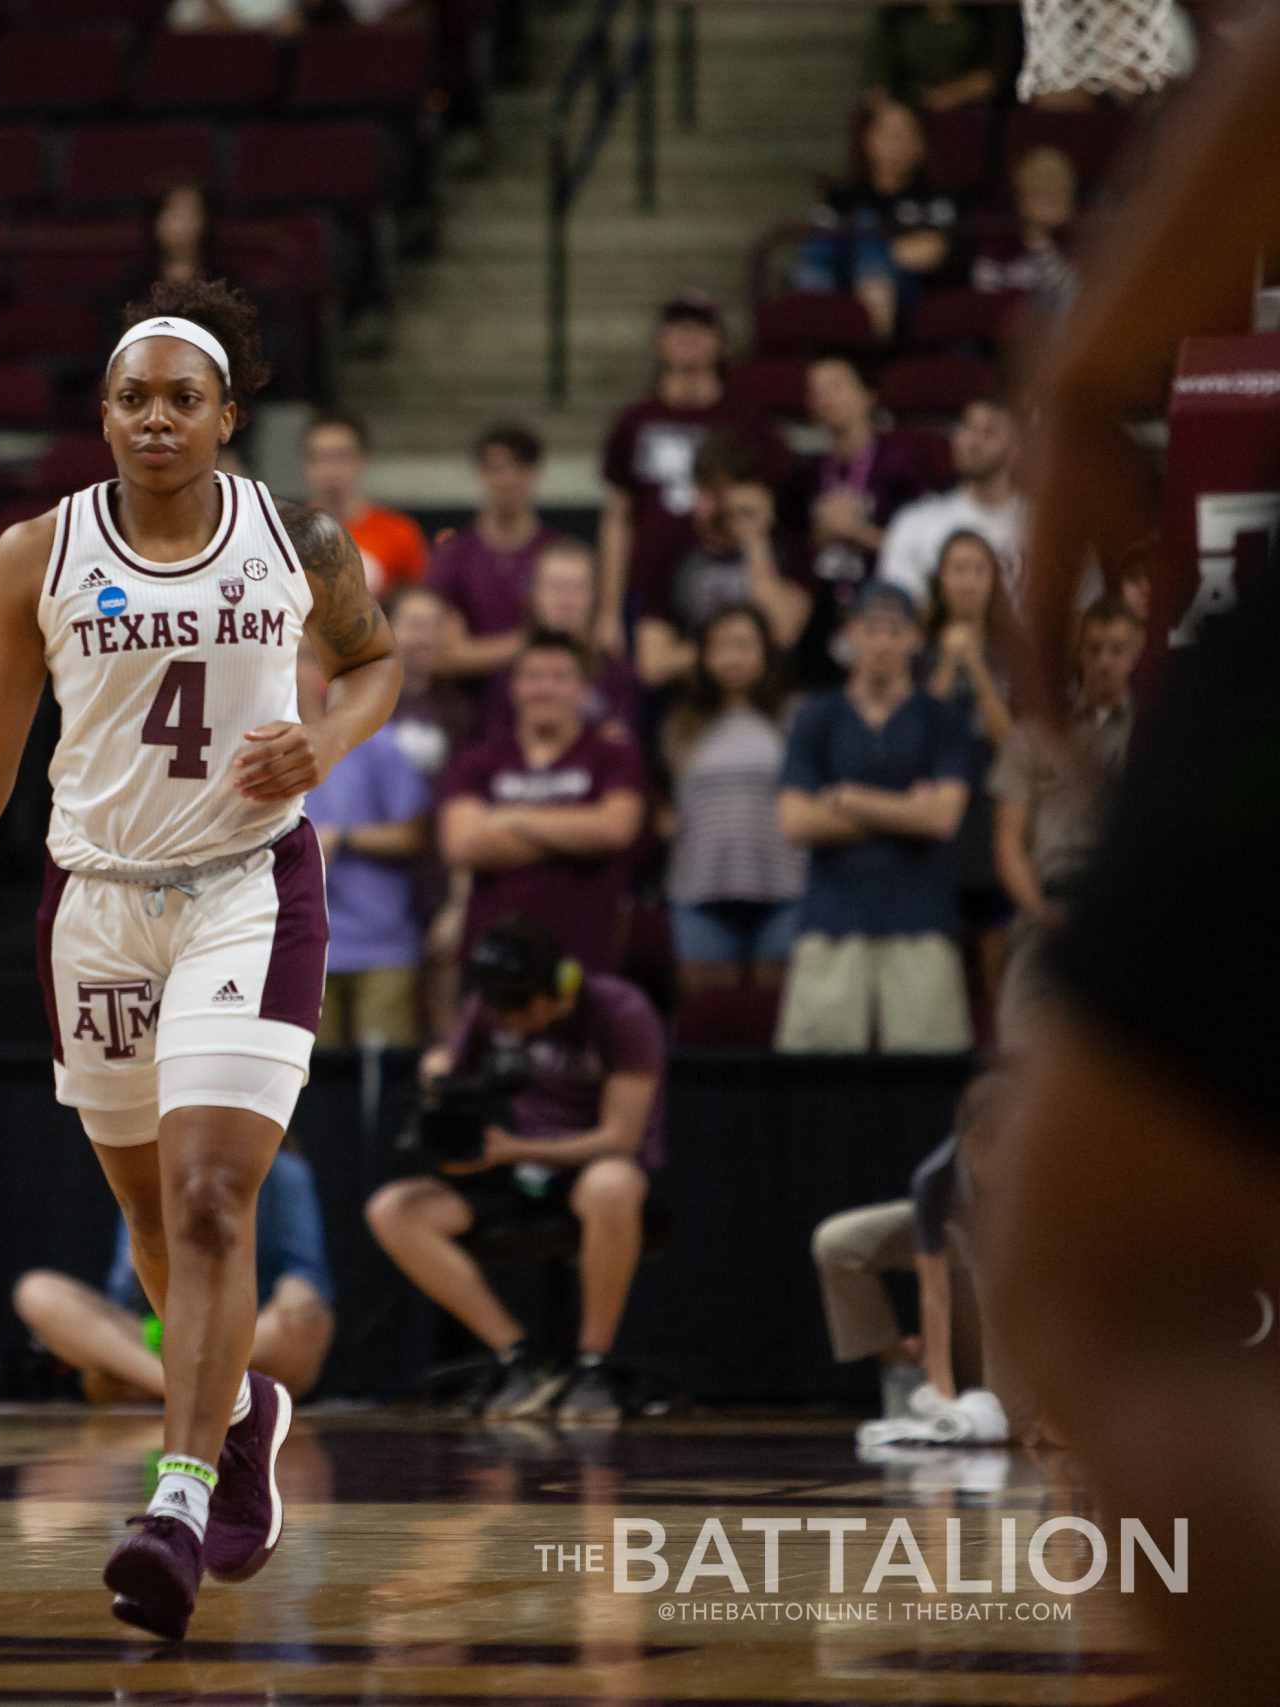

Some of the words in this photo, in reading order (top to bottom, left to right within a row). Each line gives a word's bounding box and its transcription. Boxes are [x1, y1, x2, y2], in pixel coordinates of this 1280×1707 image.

[79, 578, 113, 591] adidas
[244, 560, 267, 579] SEC
[73, 611, 199, 657] TEXAS
[215, 608, 286, 647] A&M
[141, 661, 212, 780] 4
